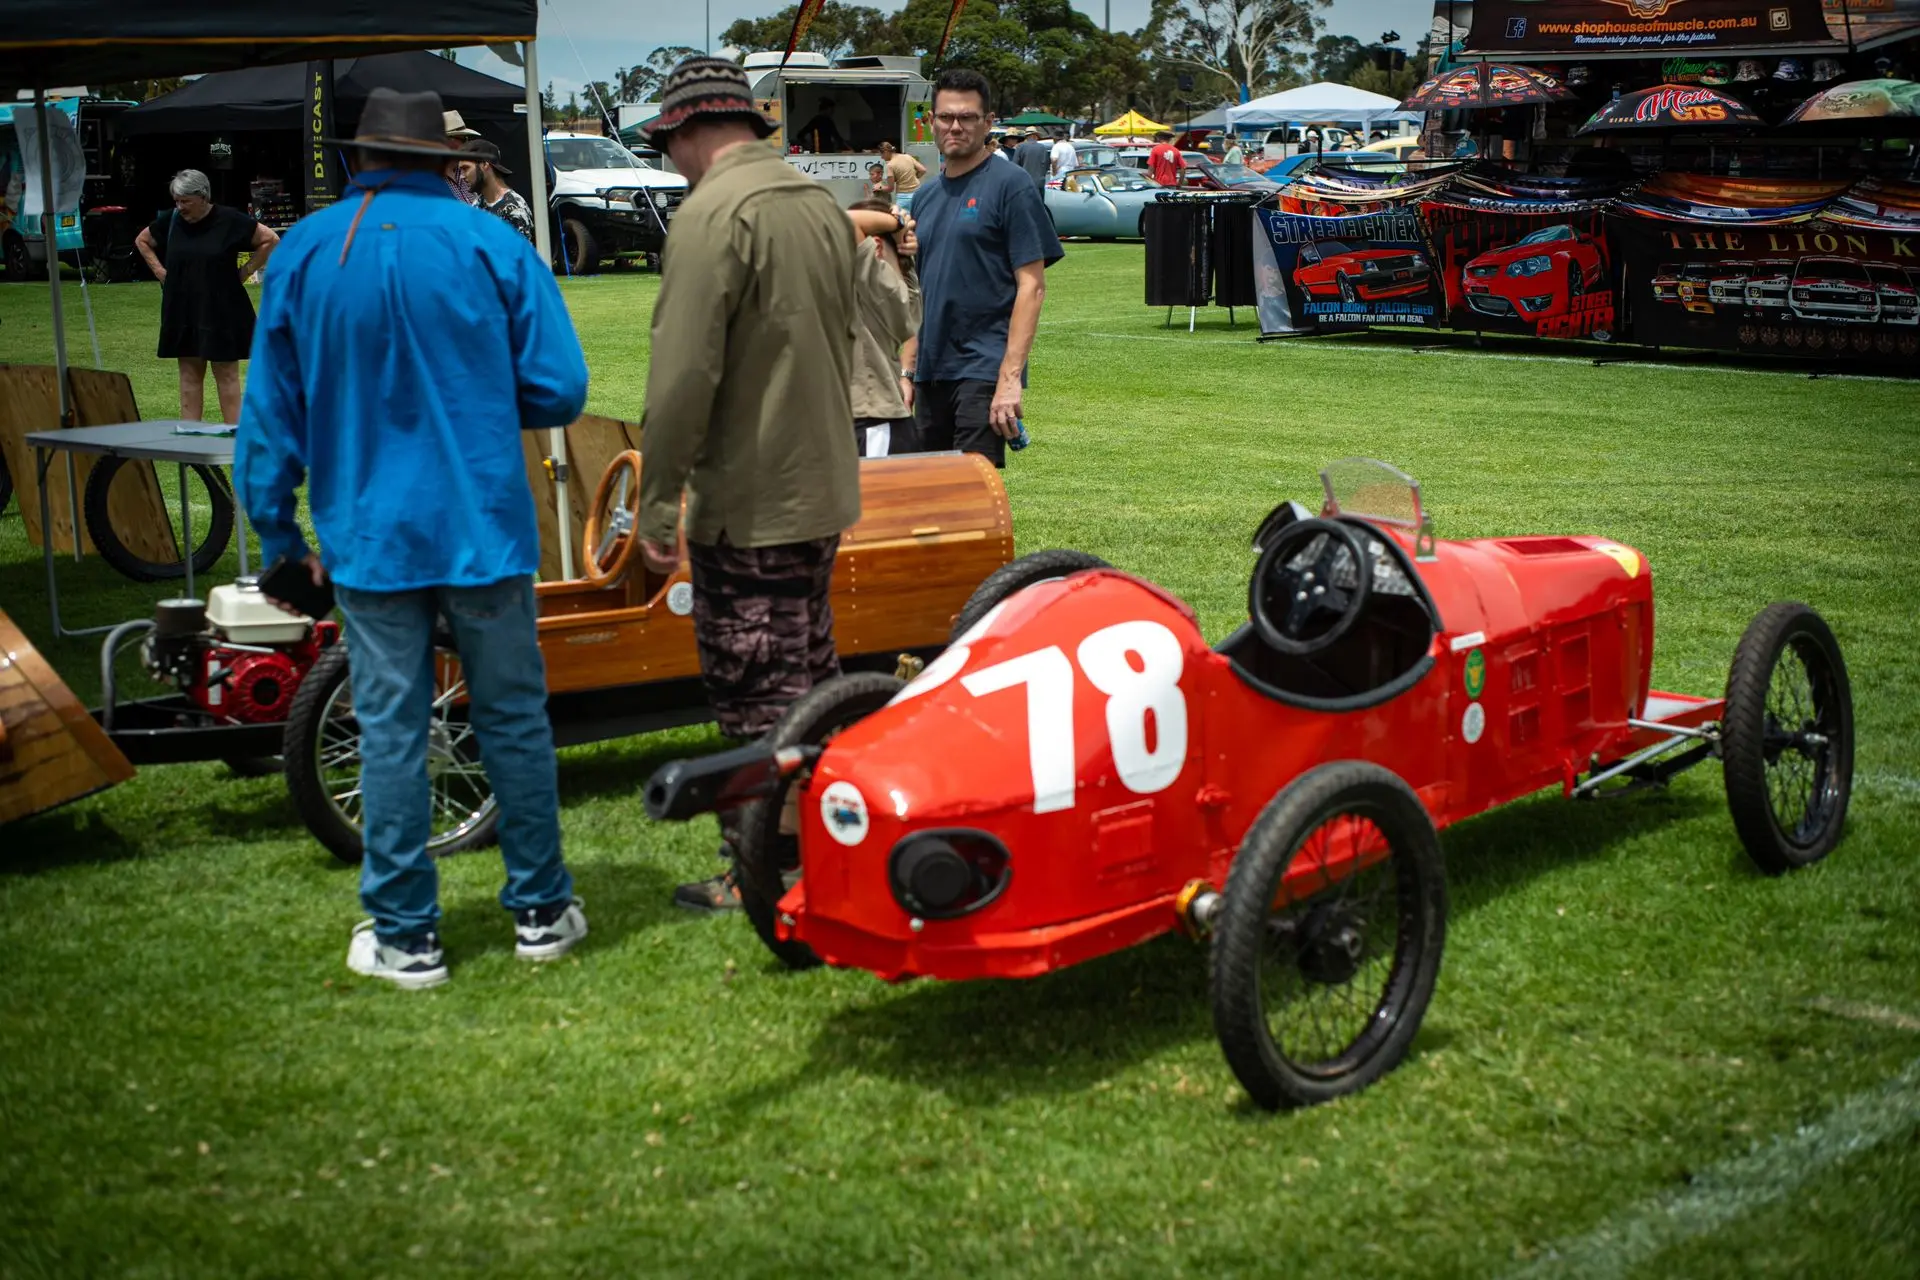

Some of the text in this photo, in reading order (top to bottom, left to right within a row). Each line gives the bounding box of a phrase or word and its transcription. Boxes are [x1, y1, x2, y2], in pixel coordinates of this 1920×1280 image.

[1539, 16, 1757, 36] www.shophouseofmuscle.com.au
[1574, 32, 1717, 46] Remembering the past, for the future.
[1668, 105, 1729, 122] GTS
[313, 72, 324, 179] DIECAST
[1662, 230, 1916, 257] THE LION K
[1303, 302, 1341, 315] FALCON
[1342, 302, 1369, 314] BORN
[1374, 302, 1411, 314] FALCON
[1571, 290, 1613, 311] STREET
[1318, 314, 1328, 323] BE
[1328, 314, 1334, 322] A
[1335, 313, 1361, 322] FALCON
[1362, 314, 1375, 322] FAN
[1376, 314, 1395, 323] UNTIL
[1395, 315, 1406, 323] I'M
[1536, 307, 1615, 338] FIGHTER
[960, 619, 1189, 814] 78
